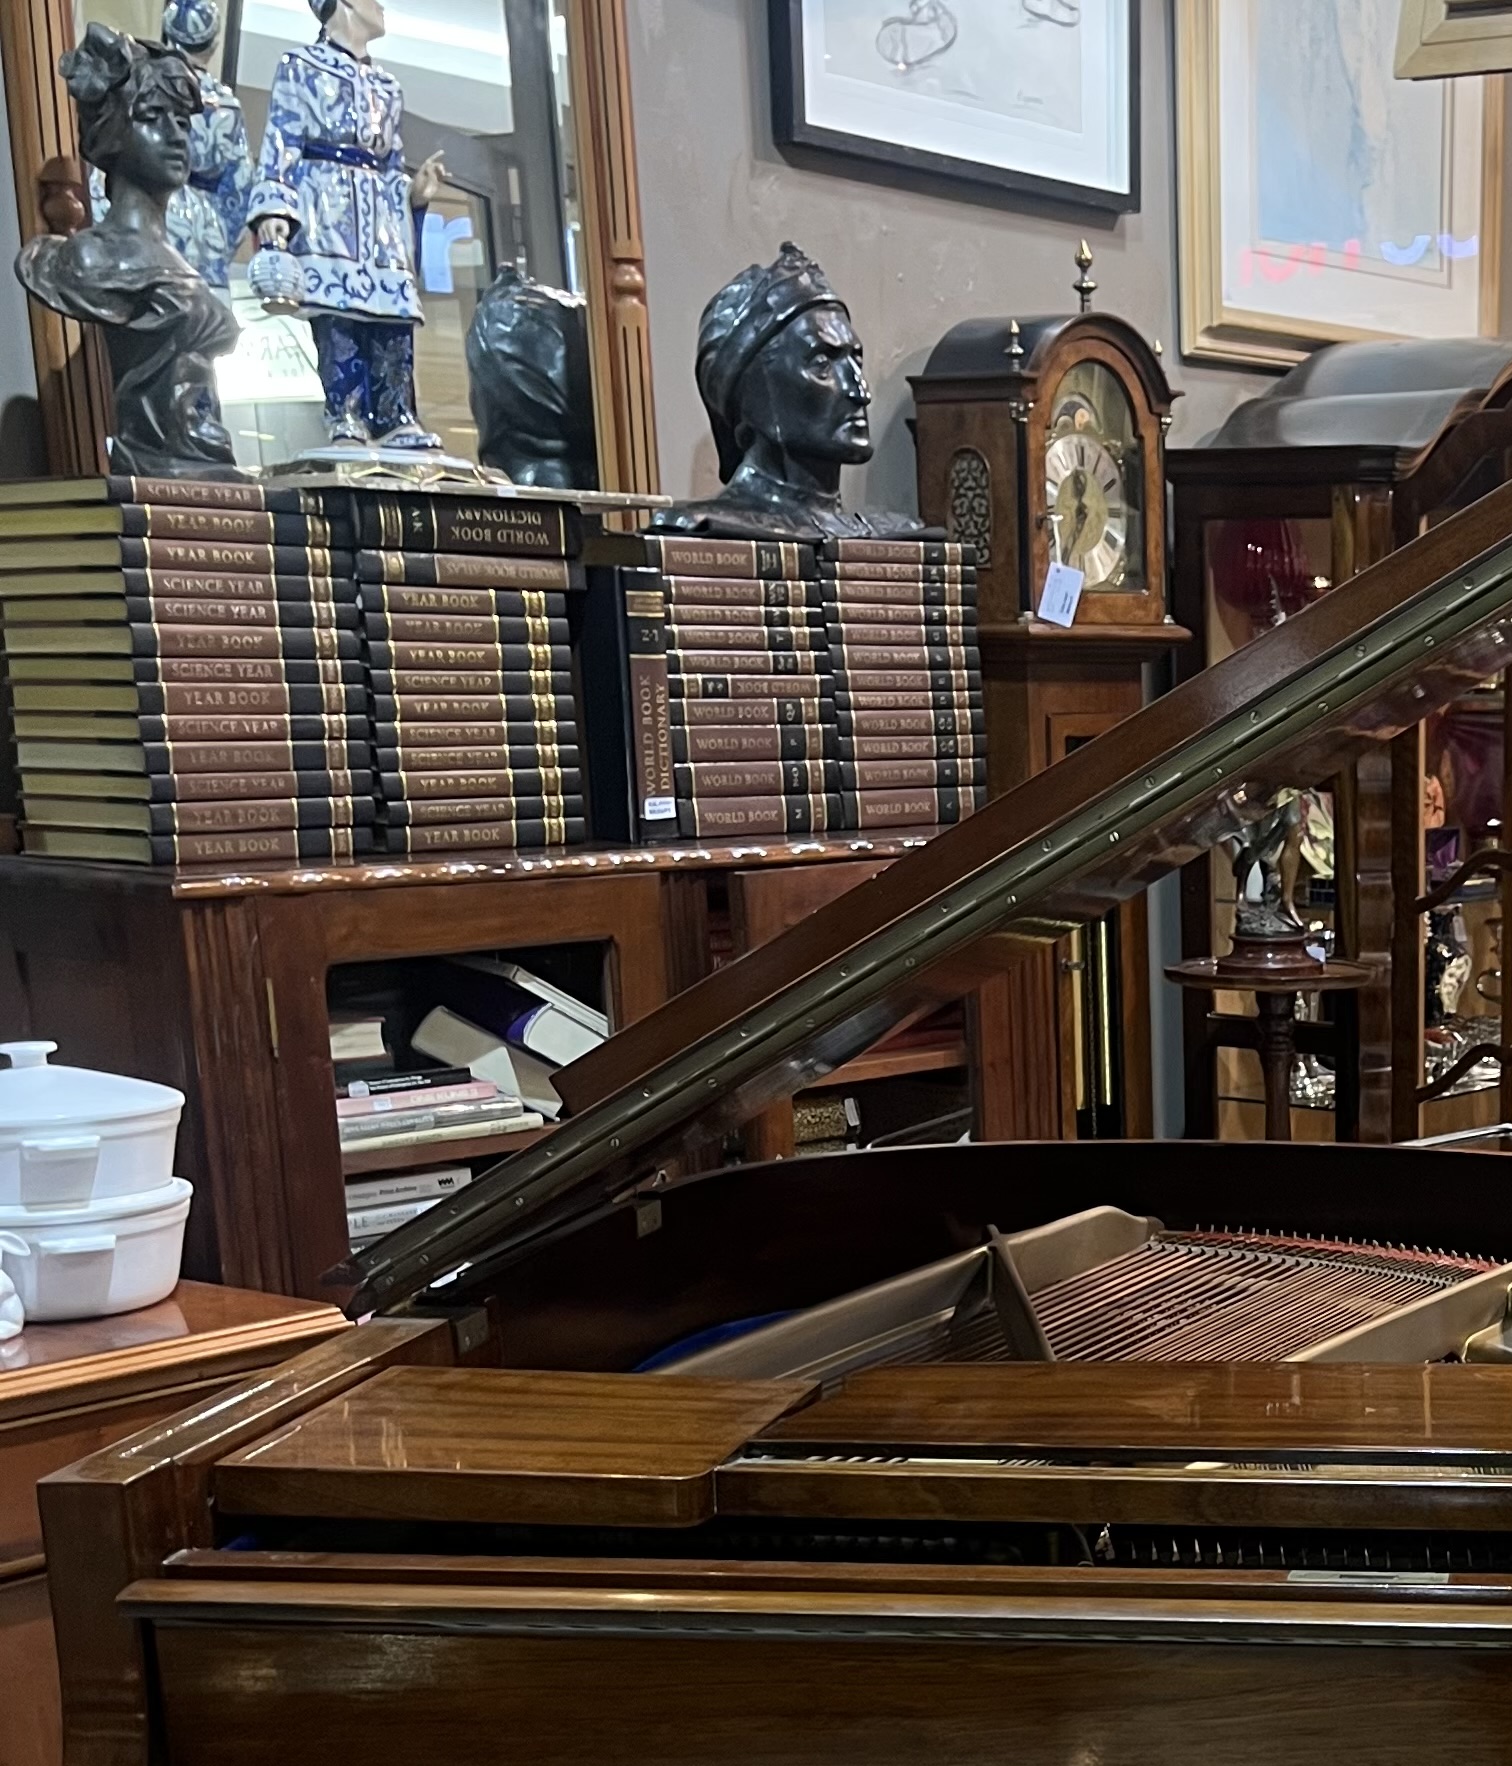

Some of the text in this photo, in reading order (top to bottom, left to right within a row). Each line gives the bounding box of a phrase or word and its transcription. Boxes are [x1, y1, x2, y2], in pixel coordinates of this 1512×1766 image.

[148, 484, 250, 503] SCIENCE YEAR
[167, 514, 254, 533] YEAR BOOK
[456, 508, 541, 525] DICTIONARY
[451, 526, 549, 546] WORLD BOOK
[167, 547, 254, 564] YEAR BOOK
[671, 552, 713, 564] WORLD
[717, 554, 748, 565] BOOK
[164, 577, 264, 595] SCIENCE YEAR
[681, 586, 722, 597] WORLD
[402, 593, 478, 608] YEAR BOOK
[165, 603, 266, 618] SCIENCE YEAR
[221, 635, 263, 649] BOOK
[410, 650, 485, 663] YEAR BOOK
[689, 655, 730, 667] WORLD
[853, 651, 891, 661] WORLD
[171, 664, 273, 678] SCIENCE YEAR
[405, 676, 491, 688] SCIENCE YEAR
[856, 675, 893, 686] WORLD
[184, 692, 270, 705] YEAR BOOK
[859, 696, 896, 706] WORLD
[414, 702, 490, 713] YEAR BOOK
[694, 706, 769, 719] WORLD BOOK
[178, 720, 278, 734] SCIENCE YEAR
[861, 719, 898, 730] WORLD
[900, 718, 926, 730] BOOK
[410, 728, 495, 740] SCIENCE YEAR
[640, 675, 656, 797] WORLD BOOK
[656, 683, 670, 790] DICTIONARY
[697, 737, 773, 750] WORLD BOOK
[862, 742, 899, 753] WORLD
[234, 750, 275, 763] BOOK
[411, 752, 463, 765] SCIENCE
[702, 772, 775, 786] WORLD BOOK
[864, 769, 929, 781] WORLD BOOK
[189, 778, 285, 793] SCIENCE YEAR
[421, 777, 497, 792] YEAR BOOK
[421, 803, 505, 818] SCIENCE YEAR
[866, 802, 931, 814] WORLD BOOK
[194, 808, 279, 824] YEAR BOOK
[705, 810, 778, 824] WORLD BOOK
[425, 829, 500, 844] YEAR BOOK
[195, 838, 279, 855] YEAR BOOK
